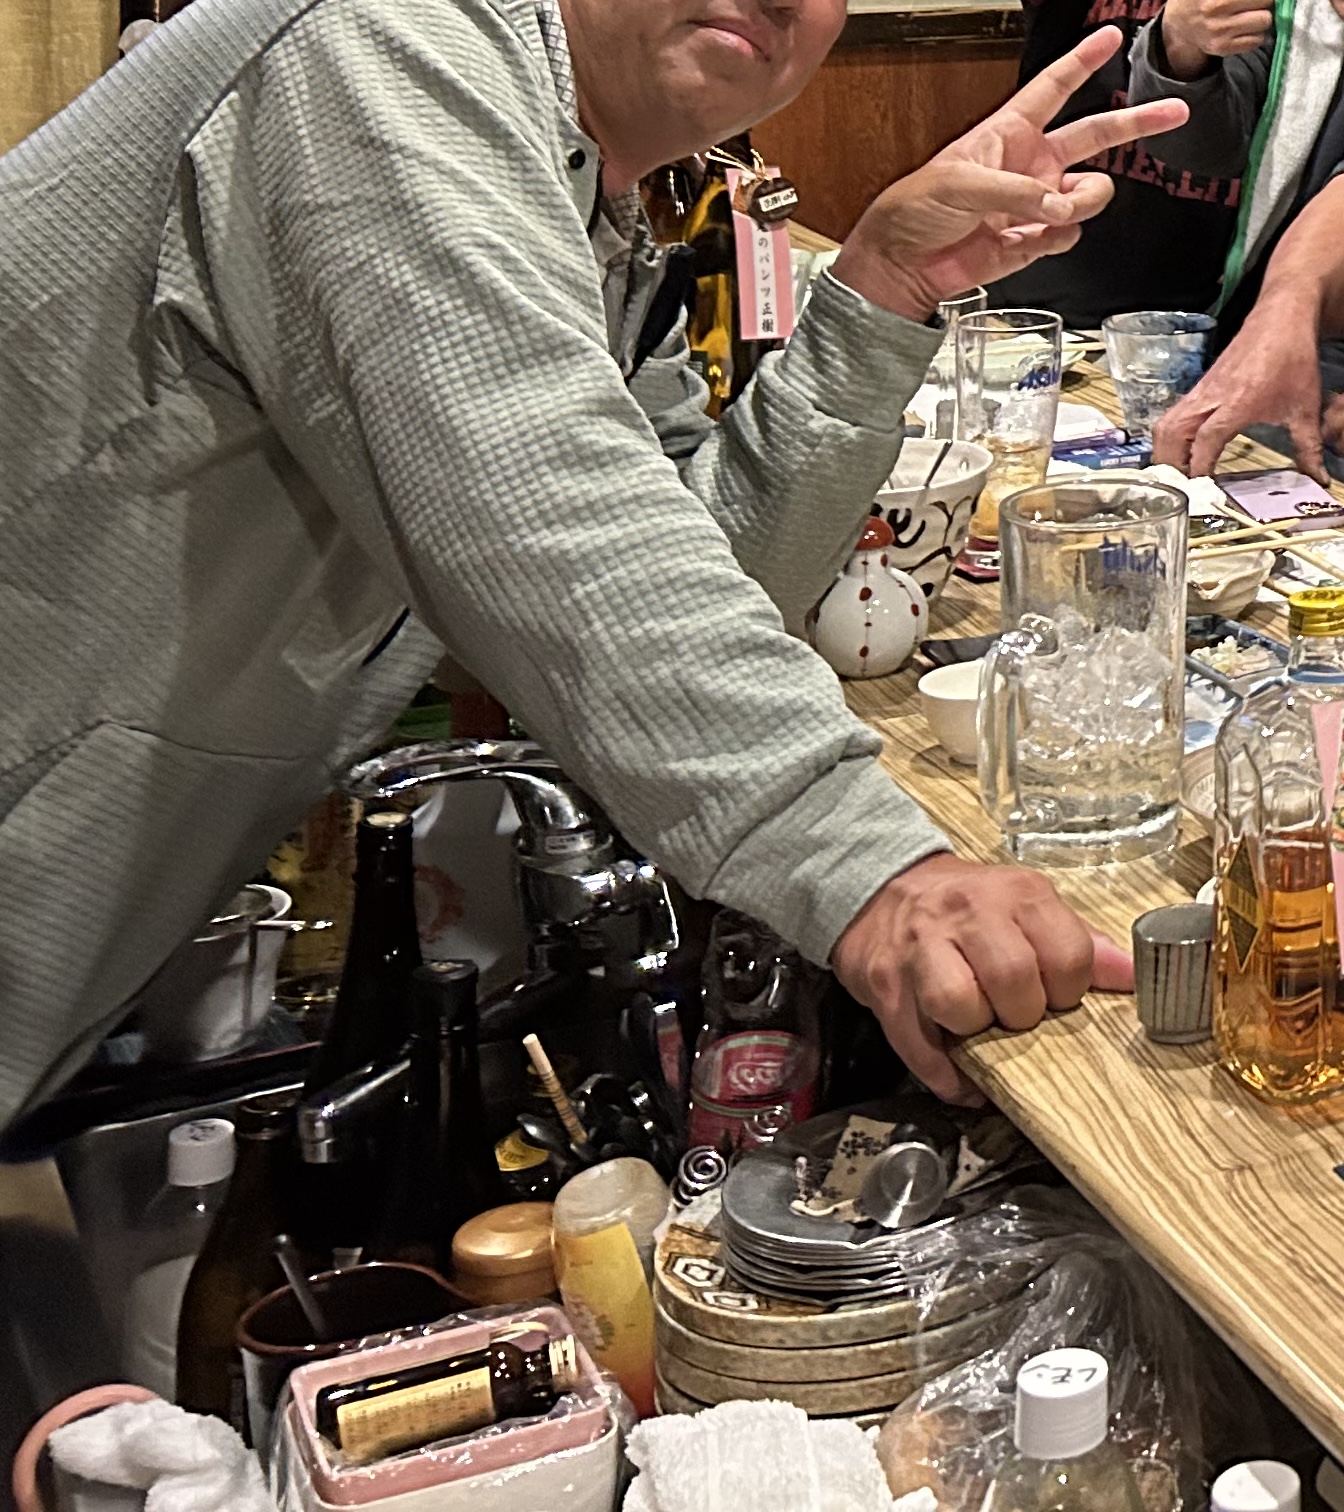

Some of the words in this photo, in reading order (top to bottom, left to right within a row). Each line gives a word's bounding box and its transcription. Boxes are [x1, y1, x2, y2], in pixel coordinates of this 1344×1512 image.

[758, 224, 775, 334] のパンツ正樹
